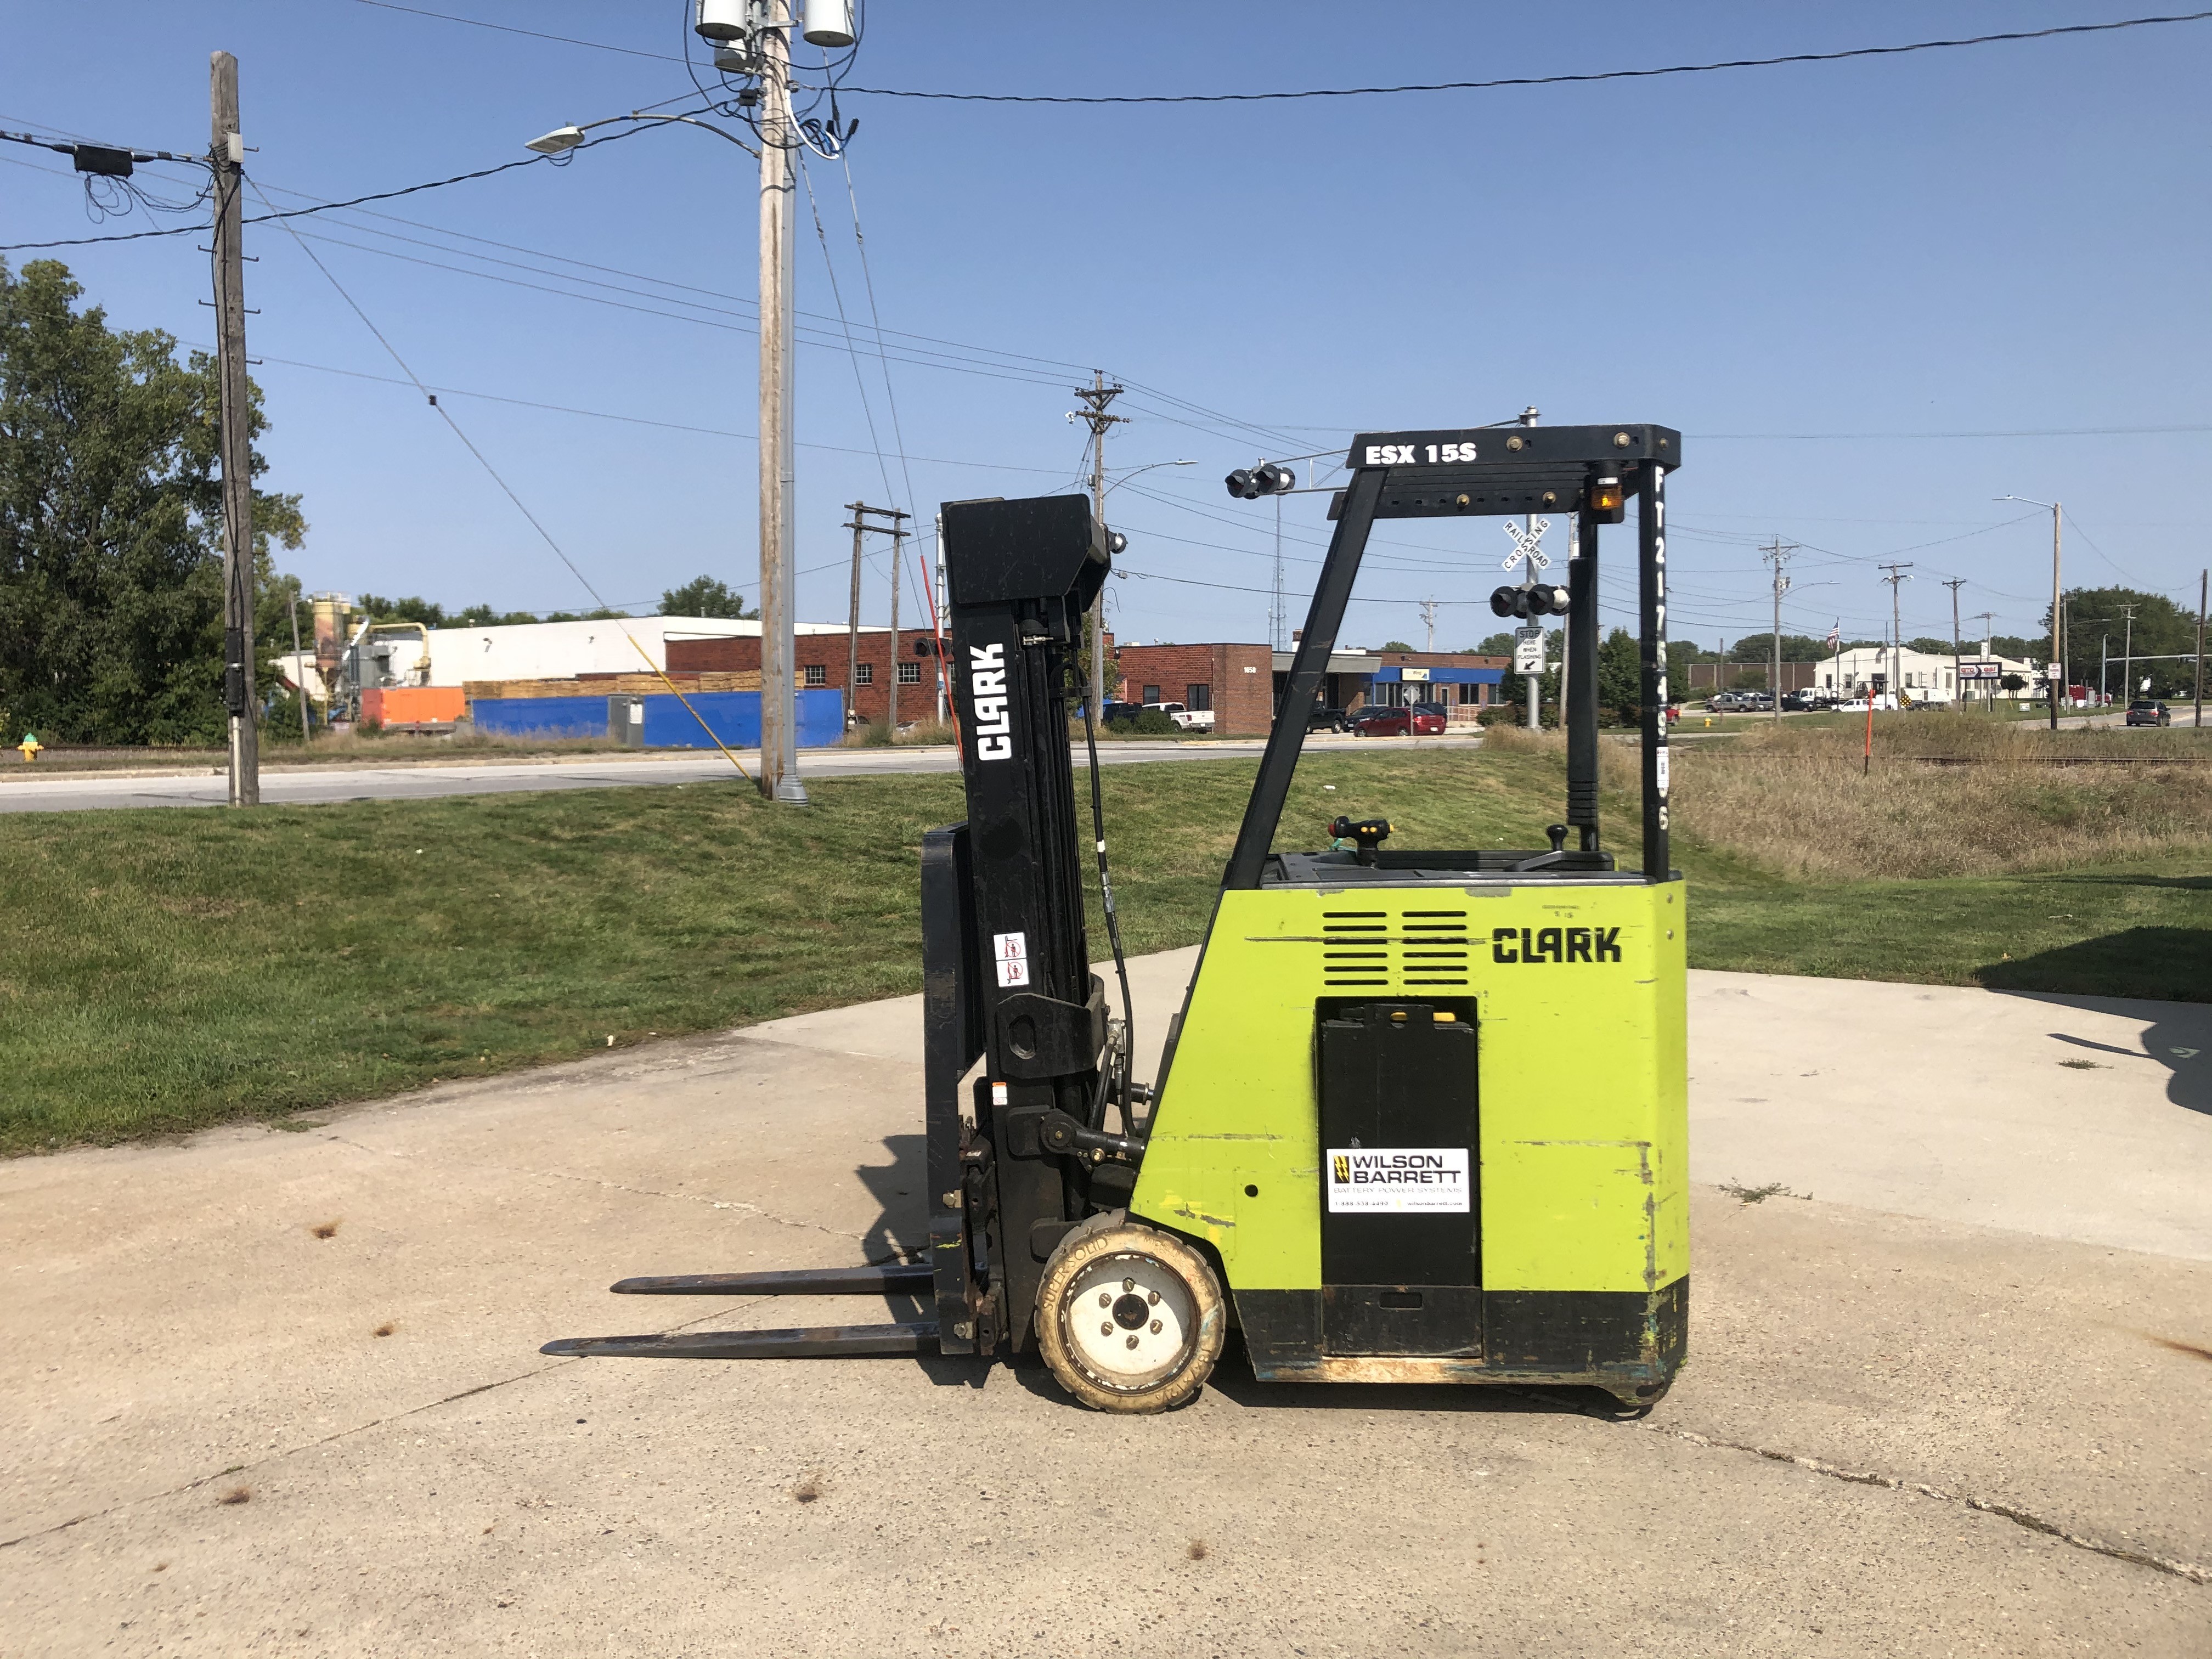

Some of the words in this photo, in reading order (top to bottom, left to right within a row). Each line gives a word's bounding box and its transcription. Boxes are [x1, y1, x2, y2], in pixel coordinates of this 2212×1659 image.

[1365, 445, 1415, 464] ESX
[1425, 442, 1476, 463] 15S
[1504, 520, 1548, 568] CROSSING
[969, 643, 1012, 761] CLARK
[1492, 927, 1622, 963] CLARK
[1352, 1155, 1443, 1169] WILSON
[1353, 1170, 1462, 1183] BARRETT
[1043, 1267, 1069, 1311] SUPER
[1068, 1237, 1108, 1267] SOLID
